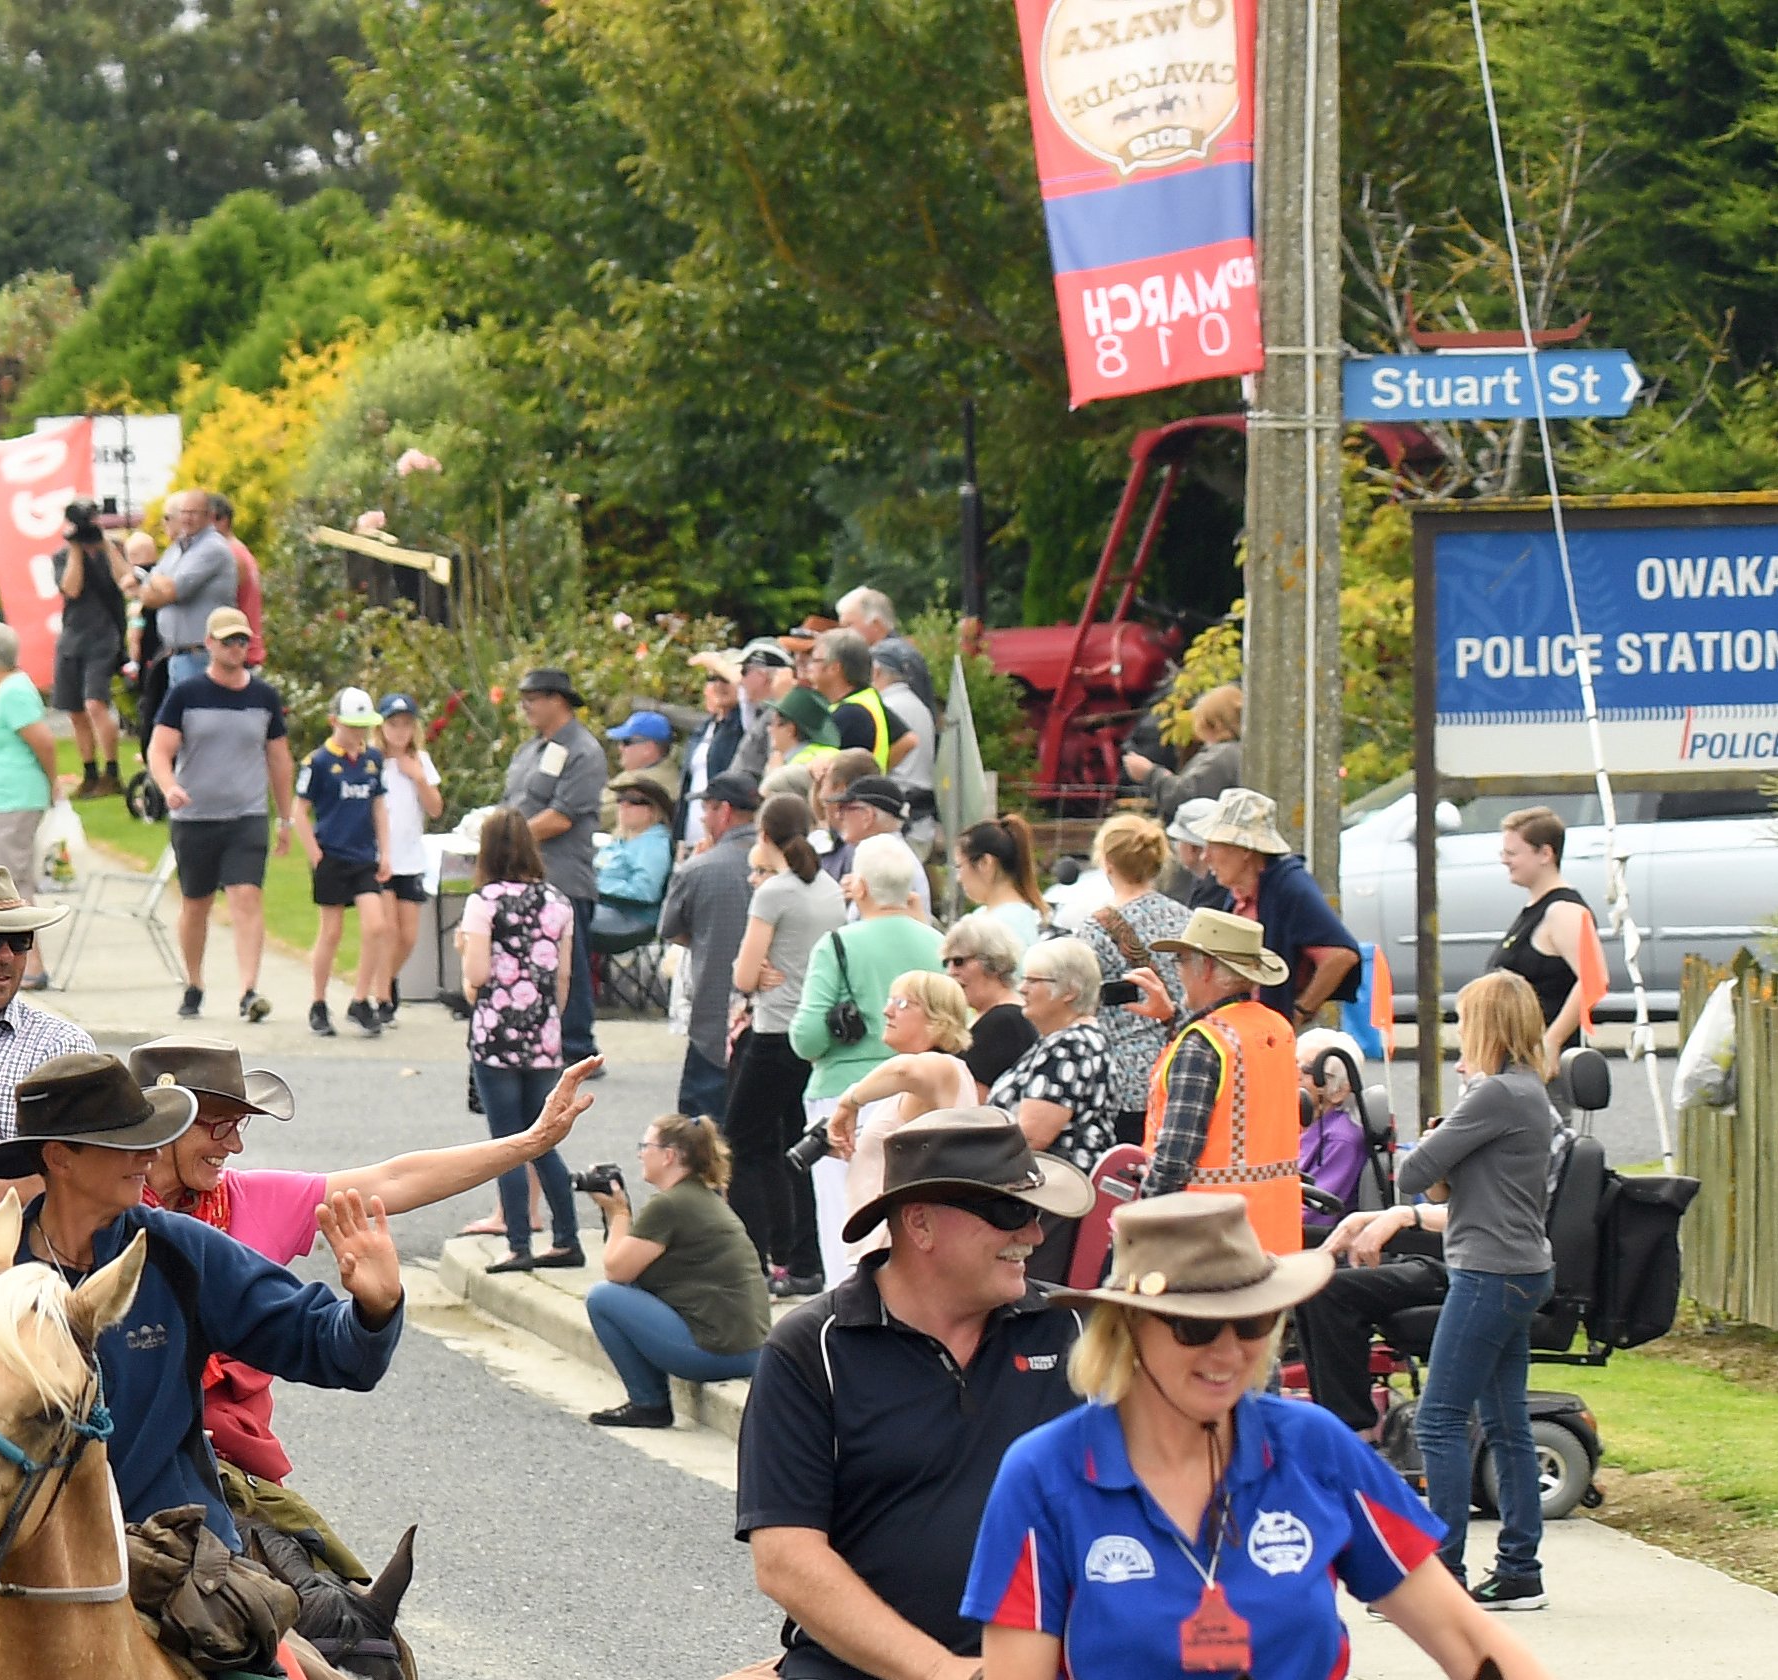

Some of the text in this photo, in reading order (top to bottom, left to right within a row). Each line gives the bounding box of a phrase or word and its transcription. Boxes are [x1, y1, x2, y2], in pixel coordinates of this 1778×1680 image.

[1371, 353, 1602, 410] Stuart St
[1635, 556, 1778, 601] OWAKA
[1455, 633, 1604, 680] POLICE
